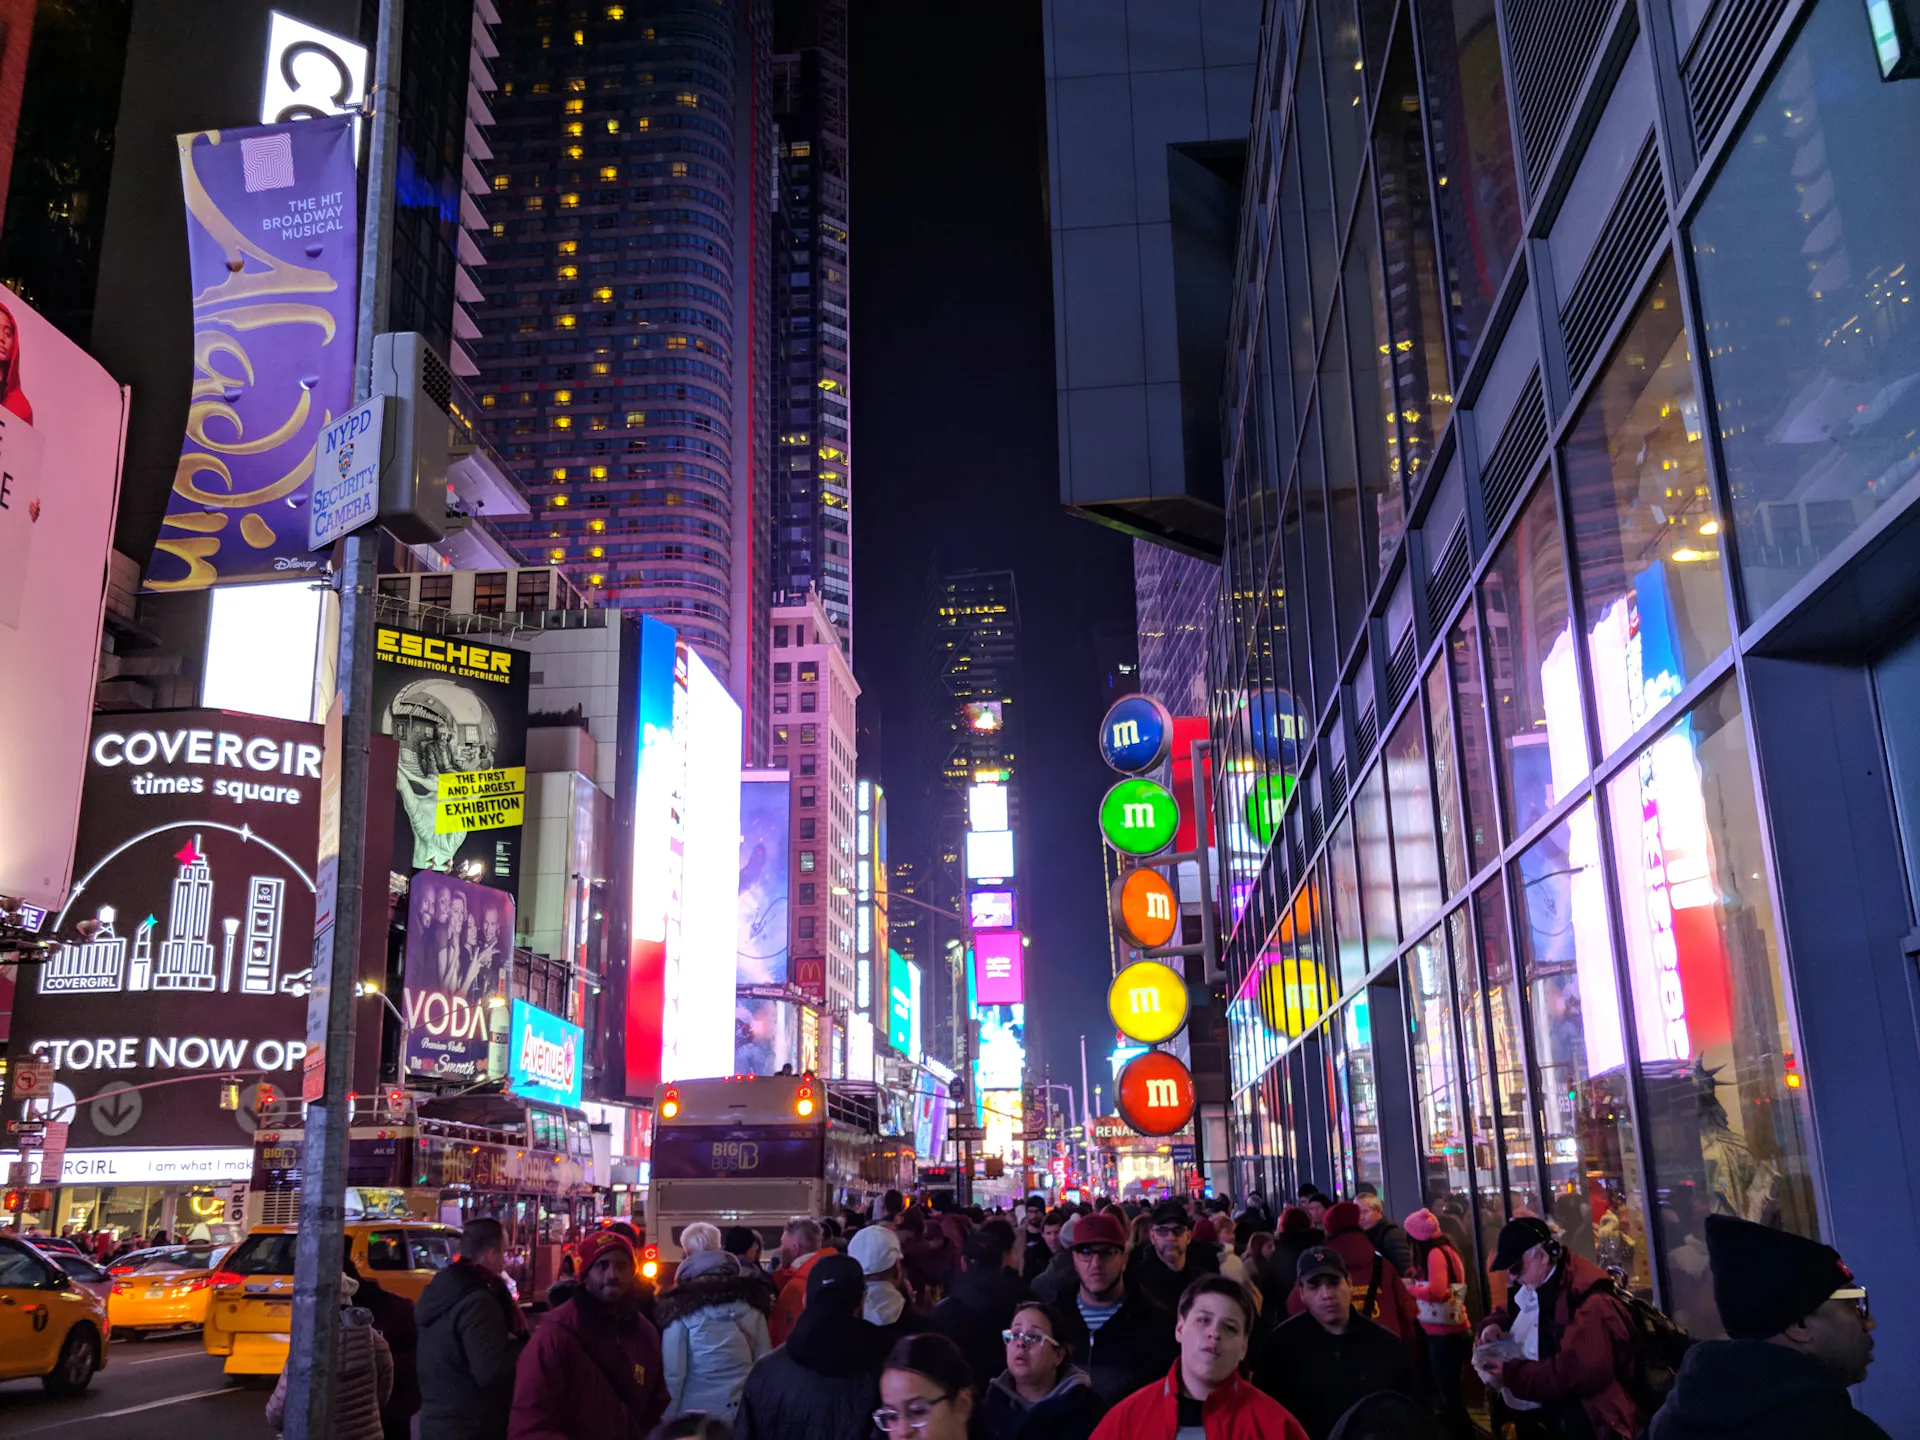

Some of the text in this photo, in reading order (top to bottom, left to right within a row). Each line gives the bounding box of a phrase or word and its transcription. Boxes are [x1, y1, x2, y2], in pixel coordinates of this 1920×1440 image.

[288, 192, 343, 212] THE HIT
[262, 205, 343, 230] BROADWAY
[282, 219, 343, 240] MUSICAL
[326, 409, 372, 454] NYPD
[313, 464, 376, 515] SECURITY
[315, 492, 372, 537] CAMERA
[377, 628, 512, 674] ESCHER
[376, 652, 510, 684] THE EXHIBITION & EXPERIENCE
[1113, 719, 1140, 748] m
[94, 730, 321, 779] COVERGIR
[133, 772, 300, 804] times square
[448, 781, 515, 797] AND LARGEST
[455, 771, 506, 783] THE FIRST
[445, 797, 520, 816] EXHIBITION
[1123, 803, 1155, 828] m
[461, 812, 505, 828] IN NYC
[1146, 892, 1170, 921] m
[46, 977, 116, 989] COVERGIRL
[1129, 987, 1160, 1015] m
[404, 988, 488, 1041] VODA
[29, 1037, 307, 1071] STORE NOW OP
[521, 1023, 564, 1078] Avenue
[434, 1054, 476, 1075] Smooth
[1147, 1079, 1179, 1107] m
[263, 1148, 282, 1158] BIG
[713, 1142, 739, 1156] BIG
[155, 1163, 176, 1172] am
[180, 1160, 212, 1171] what
[224, 1159, 253, 1170] mak
[262, 1158, 282, 1169] BUS
[442, 1148, 547, 1188] BIG BUS NEW YORK
[712, 1157, 738, 1170] BUS
